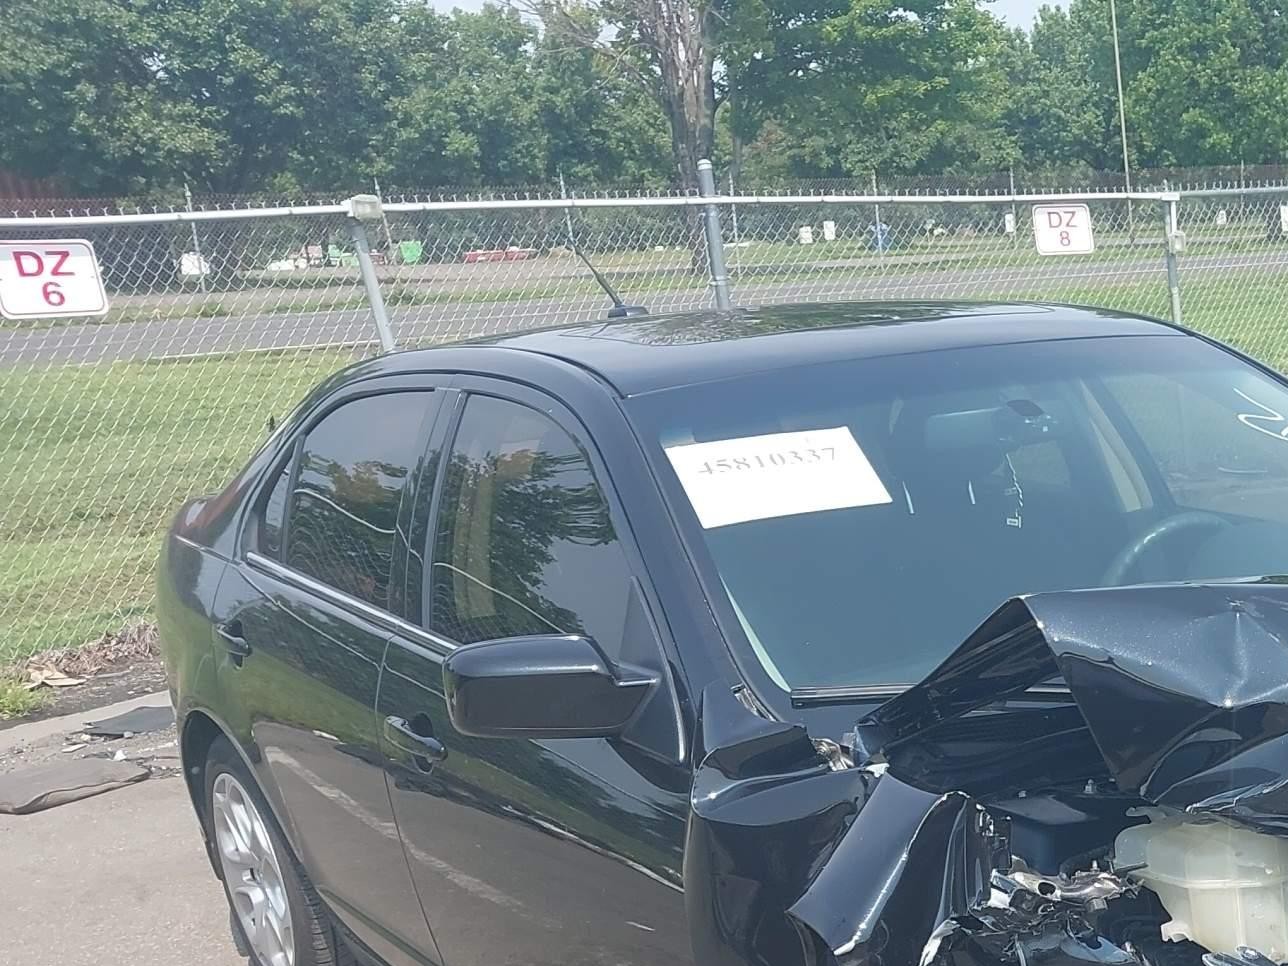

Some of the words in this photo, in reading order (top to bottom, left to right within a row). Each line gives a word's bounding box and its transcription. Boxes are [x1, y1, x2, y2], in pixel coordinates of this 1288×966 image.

[1047, 210, 1079, 229] DZ
[1059, 230, 1072, 247] 8
[12, 250, 76, 277] DZ
[42, 281, 66, 307] 6
[697, 446, 836, 476] 45810337
